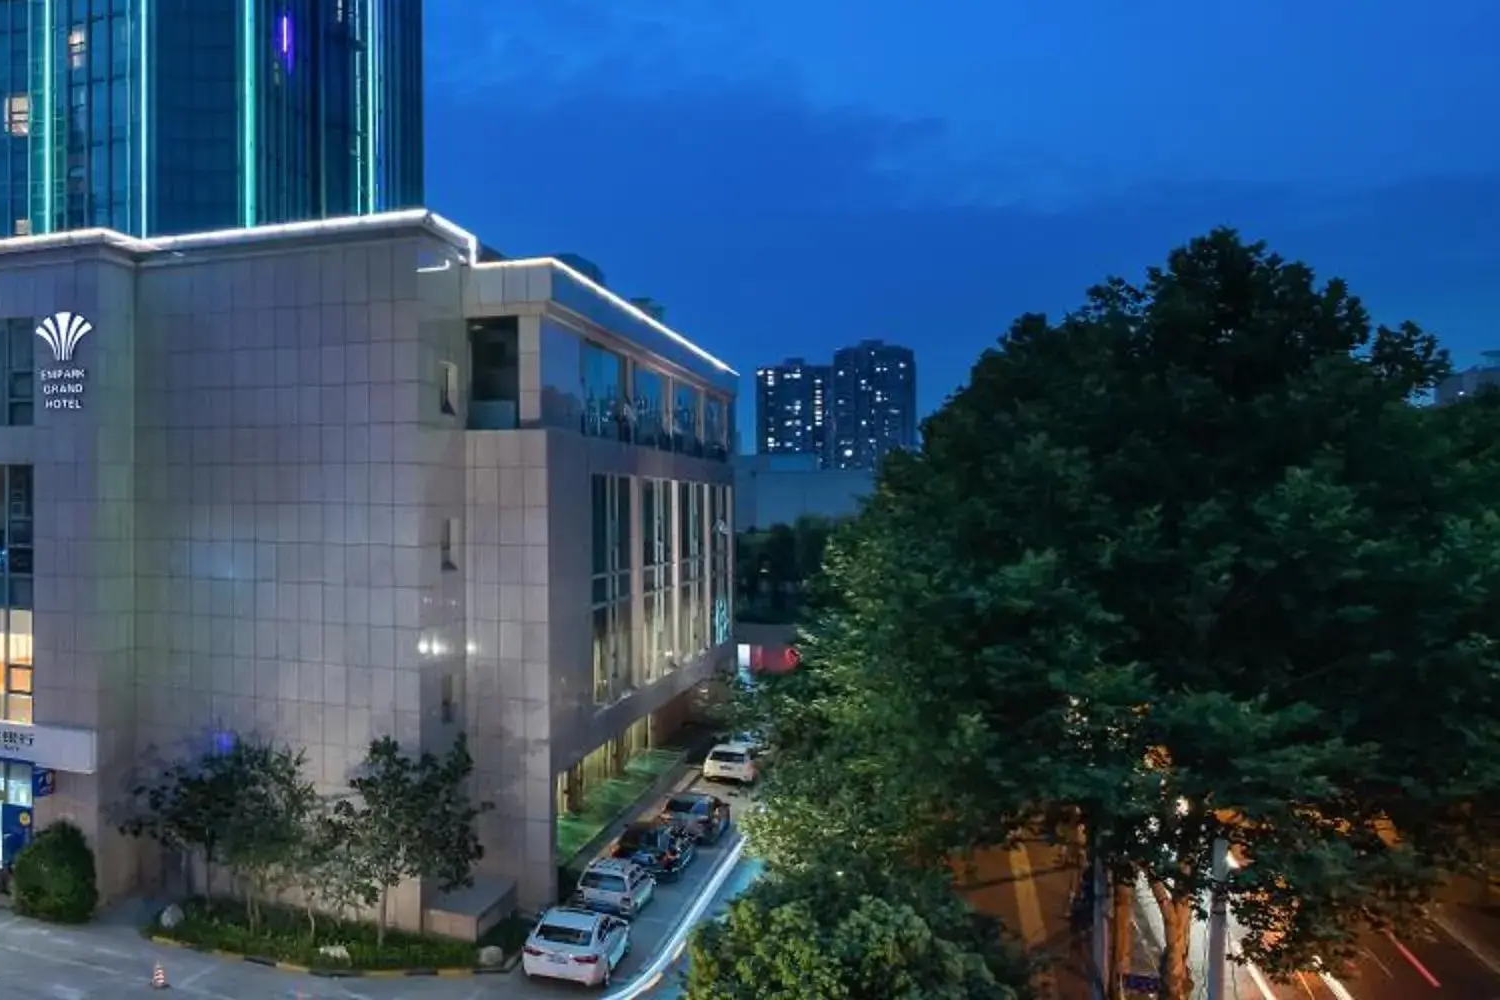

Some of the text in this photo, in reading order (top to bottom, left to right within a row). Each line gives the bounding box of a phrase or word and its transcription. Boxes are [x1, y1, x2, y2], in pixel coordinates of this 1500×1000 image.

[40, 368, 85, 381] EMPARK
[43, 383, 83, 395] GRAND
[45, 399, 82, 409] HOTEL
